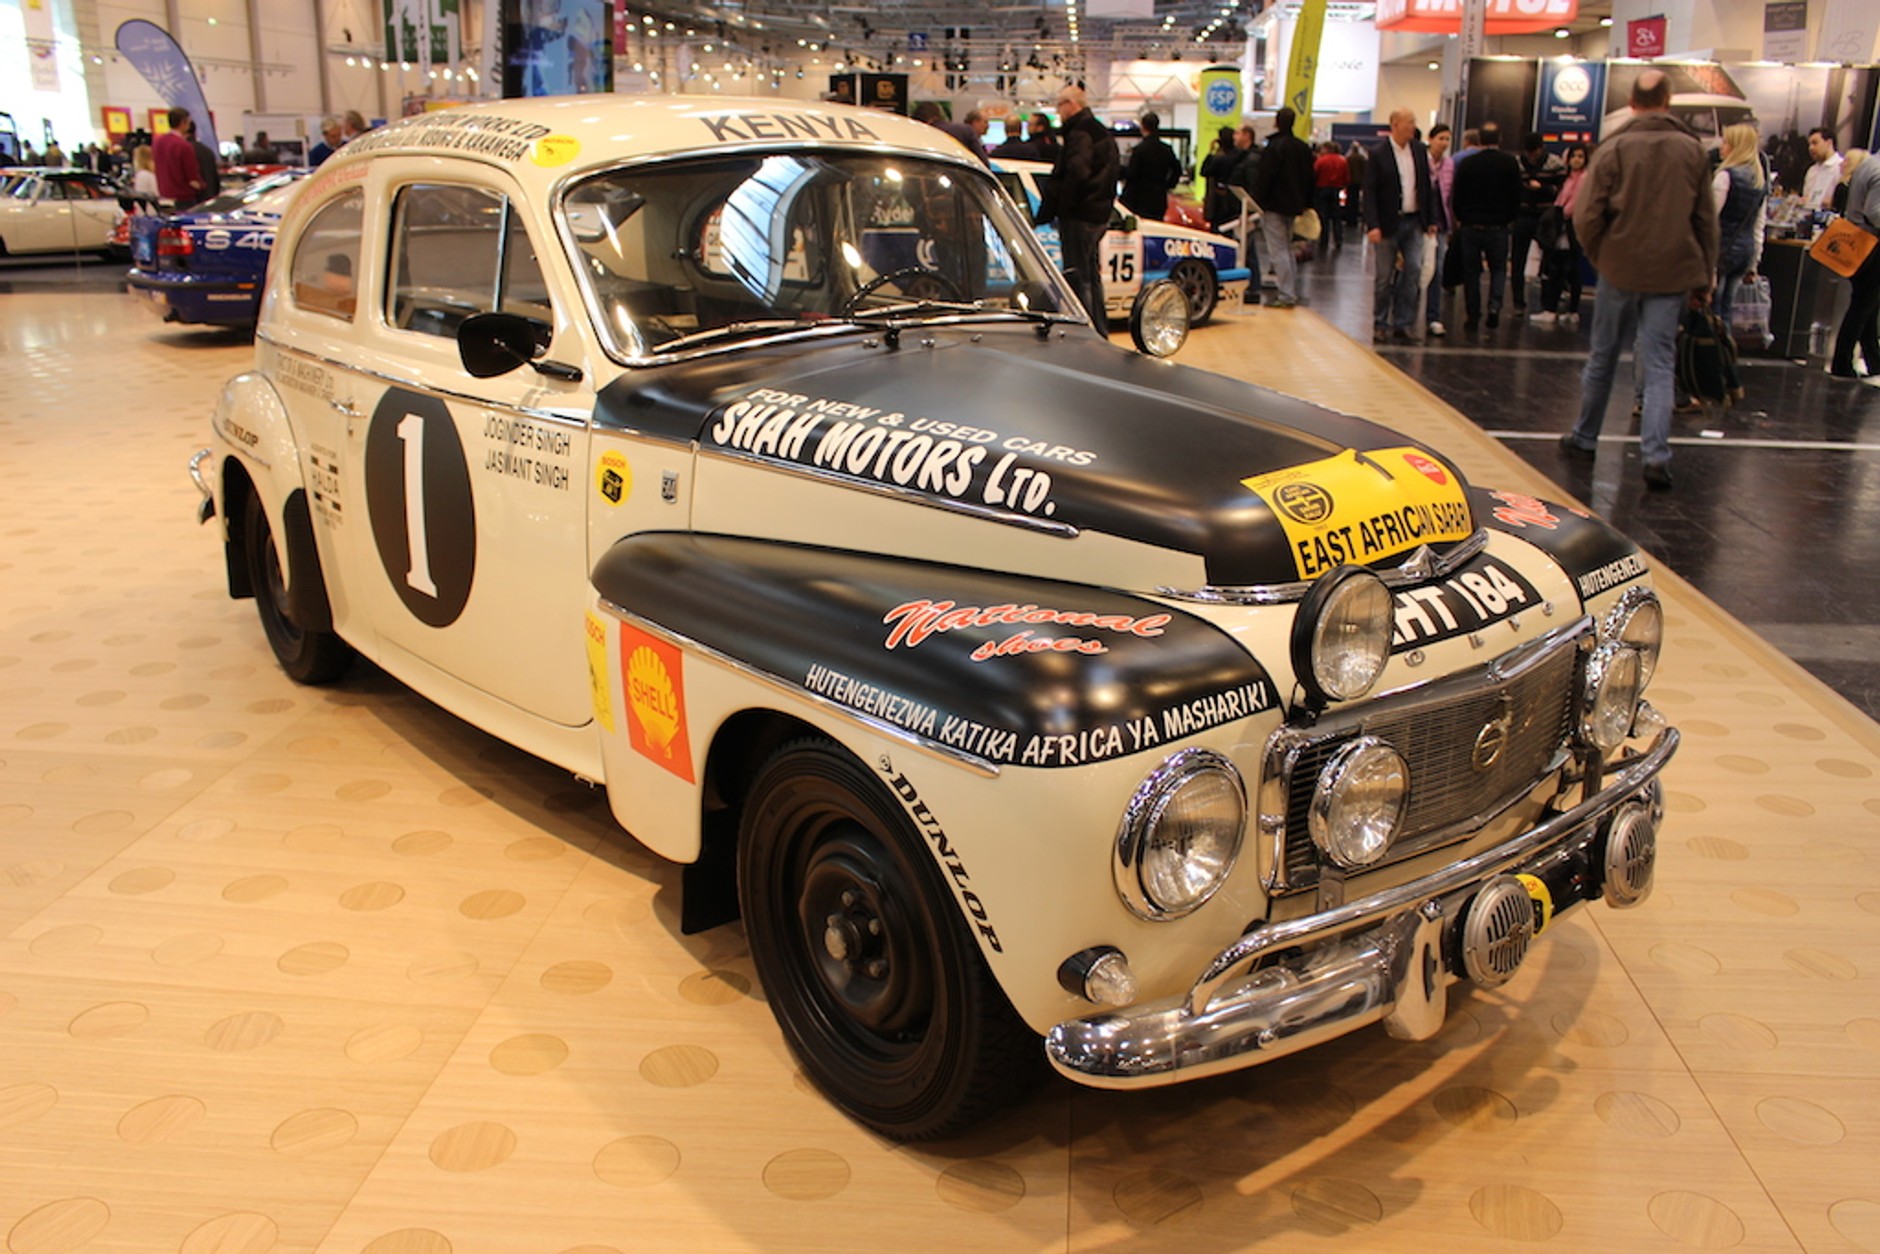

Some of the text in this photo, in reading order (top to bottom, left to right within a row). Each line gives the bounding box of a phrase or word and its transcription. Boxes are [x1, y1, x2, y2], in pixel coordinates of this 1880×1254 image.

[1210, 90, 1236, 105] FSP
[463, 133, 530, 162] KAKAMEGA
[510, 123, 551, 140] LTD
[699, 114, 881, 142] KENYA
[205, 230, 232, 250] S
[1108, 253, 1134, 283] 15
[484, 416, 570, 457] JOGINDER SINGH
[712, 401, 824, 462] SHAH
[813, 420, 987, 497] MOTORS
[747, 388, 1097, 467] FOR NEW & USED CARS
[485, 449, 569, 491] JASWANT SINGH
[397, 413, 438, 598] 1
[1298, 526, 1356, 576] EAST
[1359, 504, 1437, 556] AFRICAN
[1432, 501, 1471, 535] SAFARI
[883, 599, 1172, 649] National
[1392, 564, 1527, 646] HT 184
[970, 630, 1108, 662] shoes
[633, 677, 675, 721] SHELL
[805, 663, 1268, 766] HUTENGENEZWA KATIKA AFRICA YA MASHARIKI
[890, 773, 1004, 954] DUNLOP
